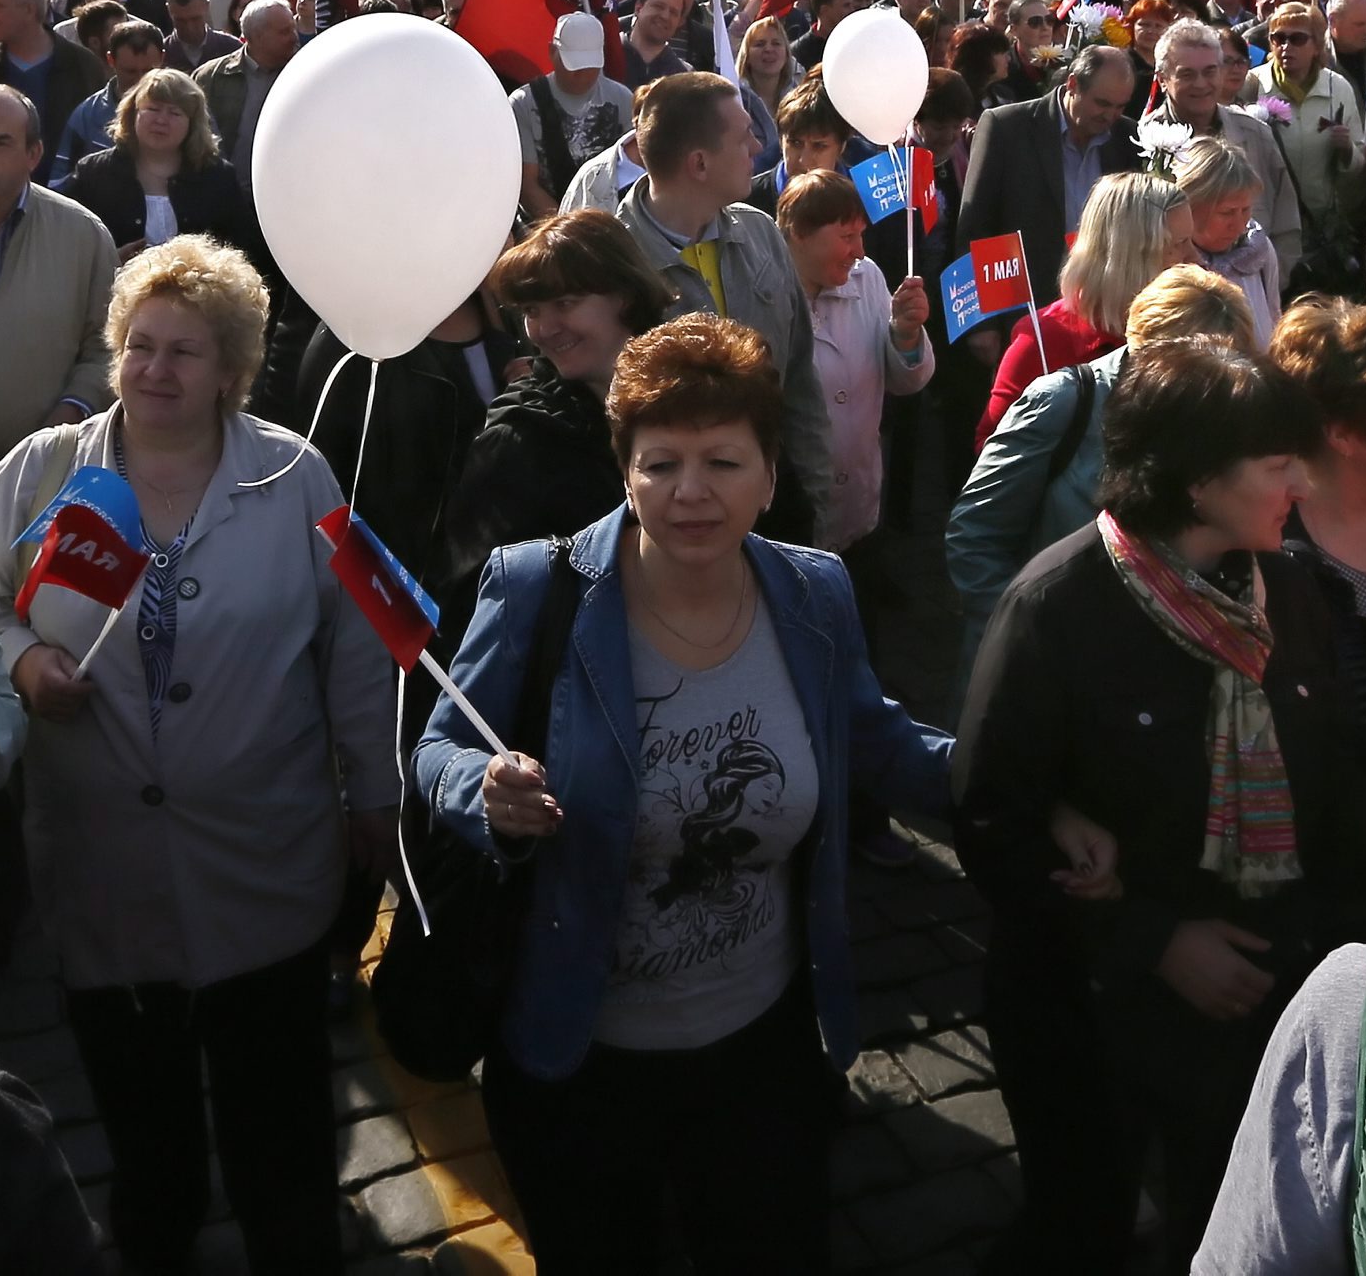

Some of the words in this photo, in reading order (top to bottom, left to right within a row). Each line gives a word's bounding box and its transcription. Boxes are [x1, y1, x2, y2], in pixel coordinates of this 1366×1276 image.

[983, 265, 990, 283] 1
[994, 258, 1020, 281] МАЯ
[636, 677, 762, 772] Forever
